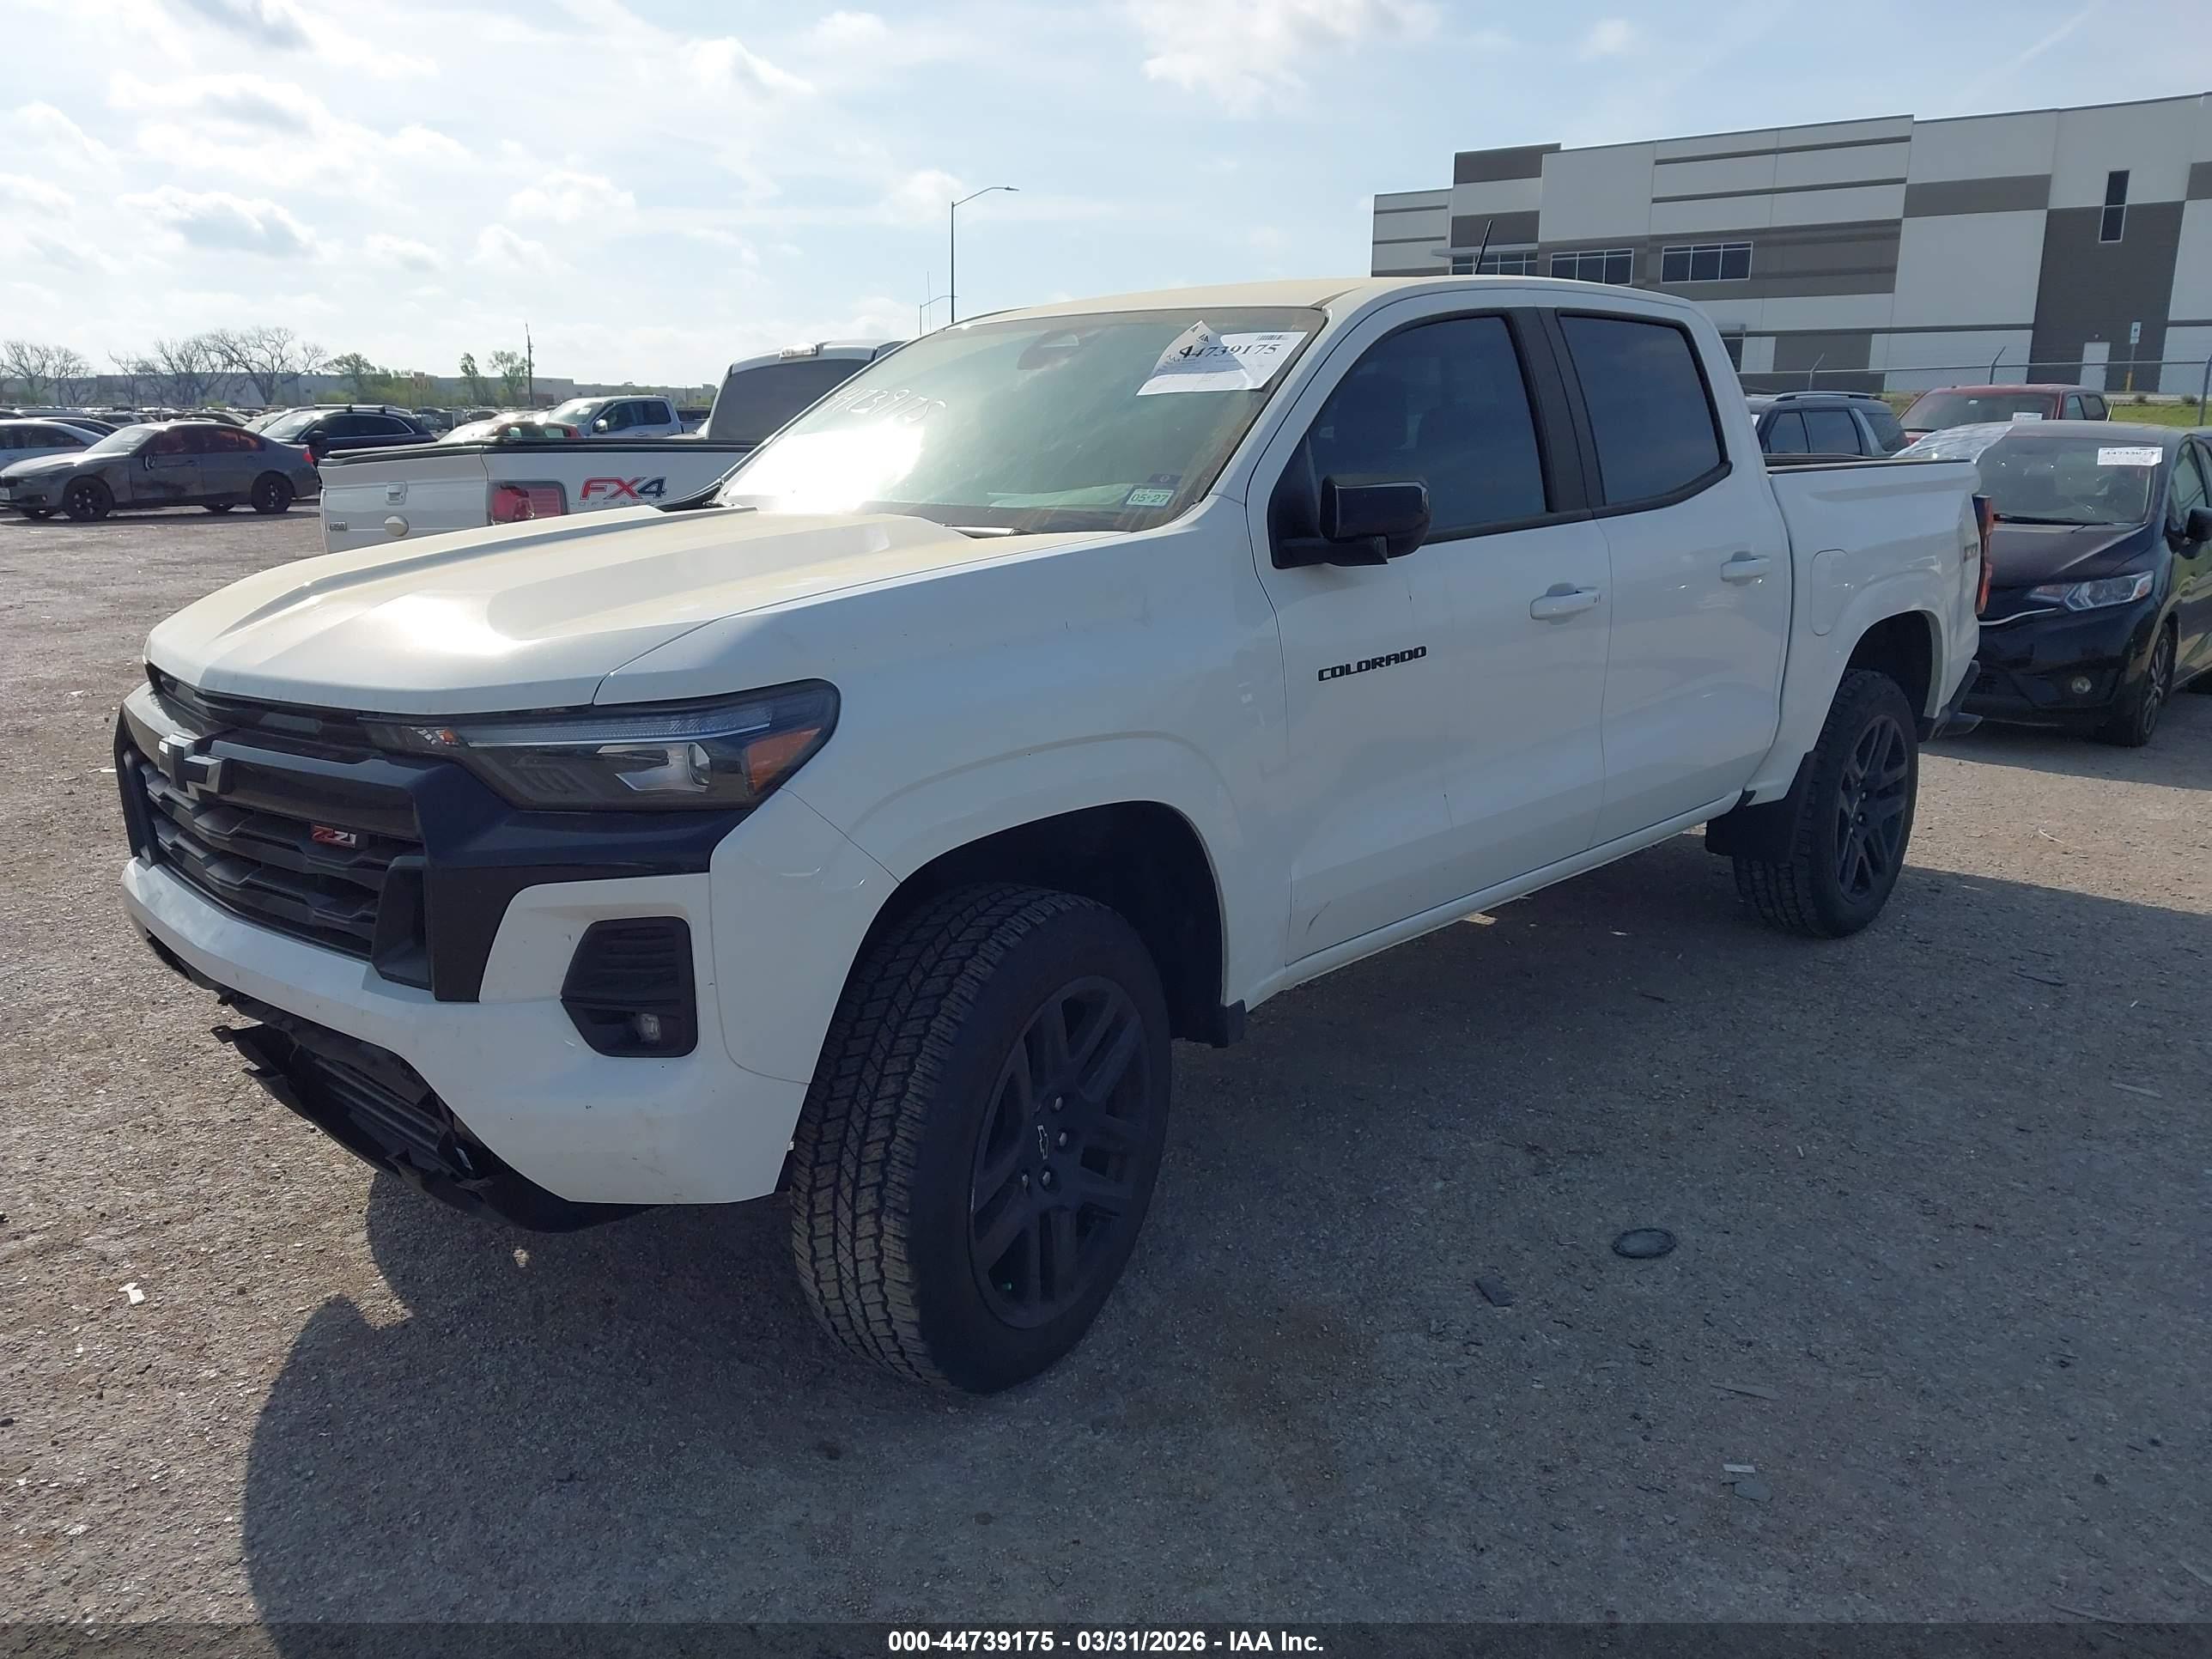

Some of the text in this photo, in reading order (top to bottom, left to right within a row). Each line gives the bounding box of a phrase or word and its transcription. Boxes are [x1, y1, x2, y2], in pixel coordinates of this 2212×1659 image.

[580, 477, 667, 501] FX4
[1318, 646, 1427, 682] COLORADO
[312, 824, 357, 849] Z71
